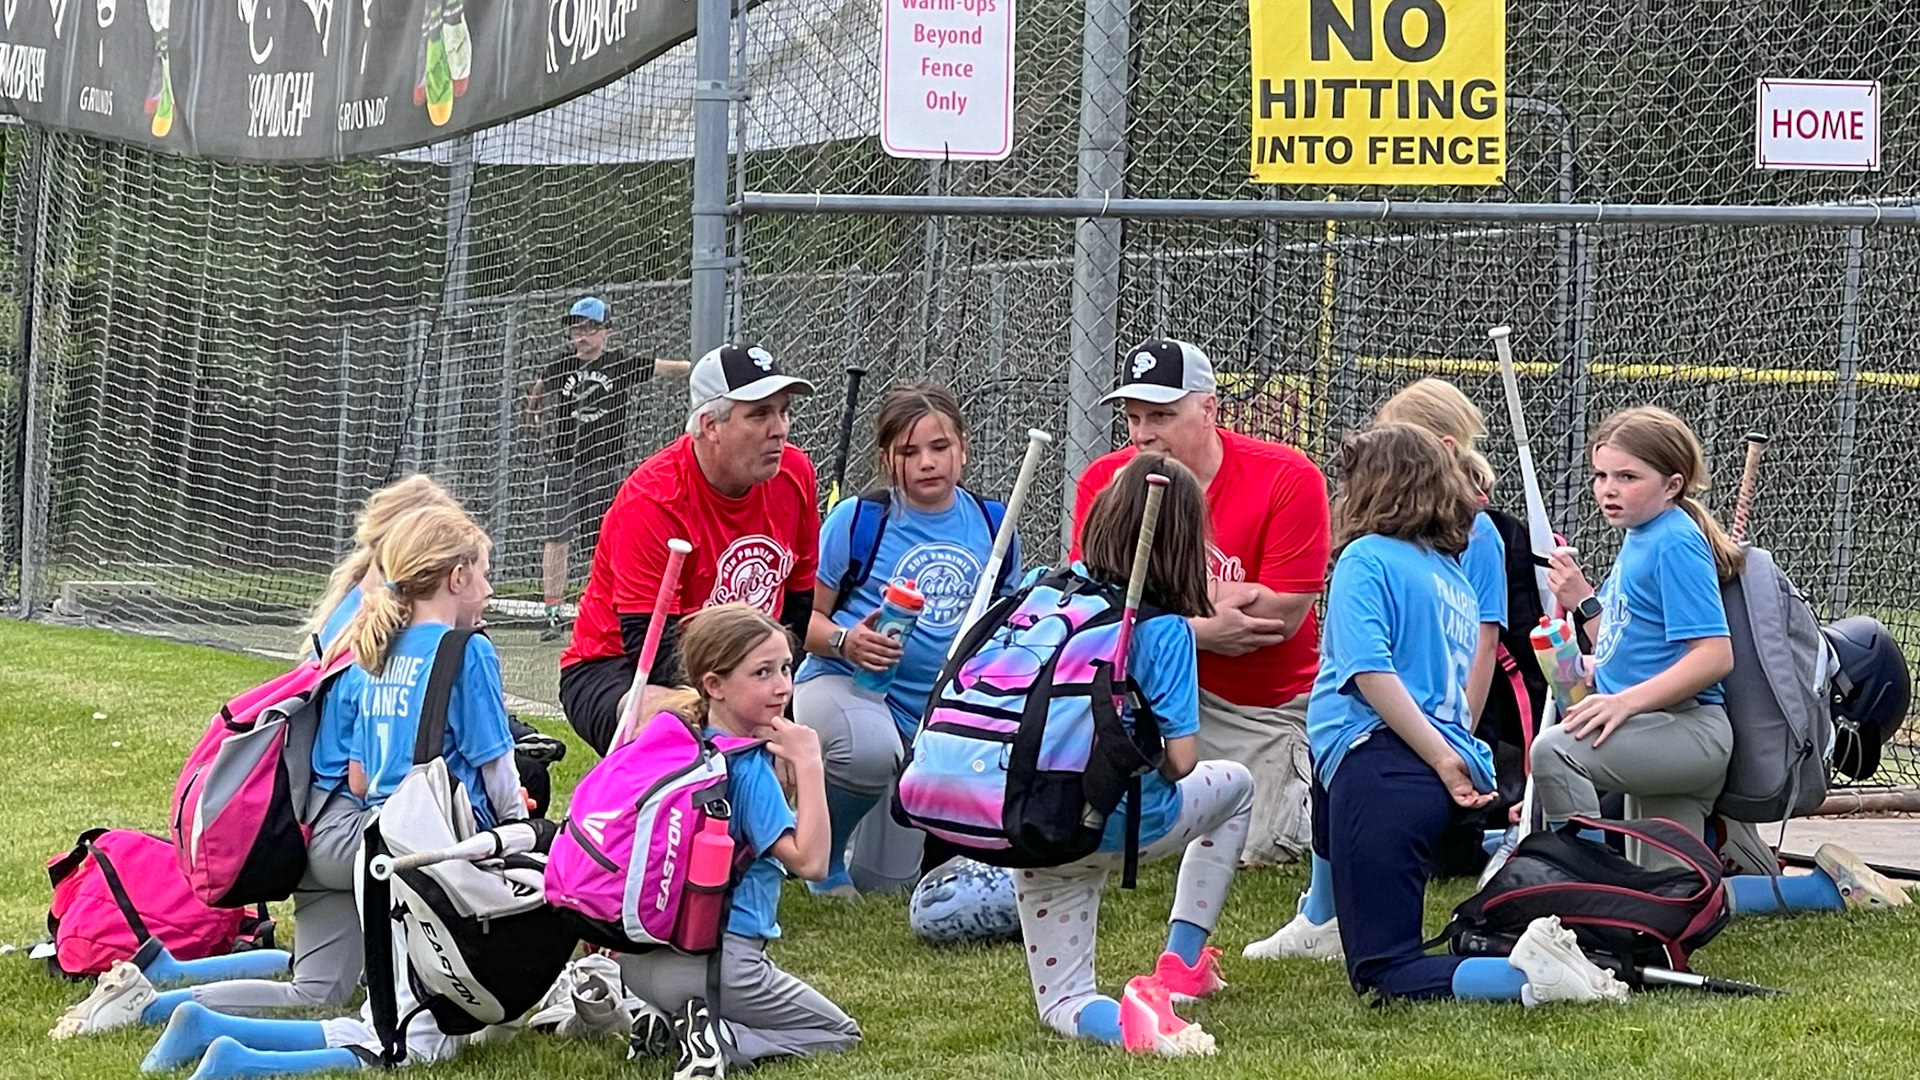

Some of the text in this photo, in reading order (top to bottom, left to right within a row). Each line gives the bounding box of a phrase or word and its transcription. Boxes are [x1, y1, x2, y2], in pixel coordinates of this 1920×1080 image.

[914, 23, 982, 49] Beyond
[1311, 0, 1446, 62] NO
[921, 57, 974, 78] Fence
[925, 90, 968, 116] Only
[1259, 79, 1498, 120] HITTING
[1773, 109, 1864, 140] HOME
[1256, 136, 1500, 165] INTO FENCE
[907, 551, 973, 575] SUN PRAIRIE
[1440, 600, 1477, 655] LANES
[370, 655, 424, 687] AIRIE
[656, 806, 684, 913] EASTON
[419, 919, 482, 1006] EASTON
